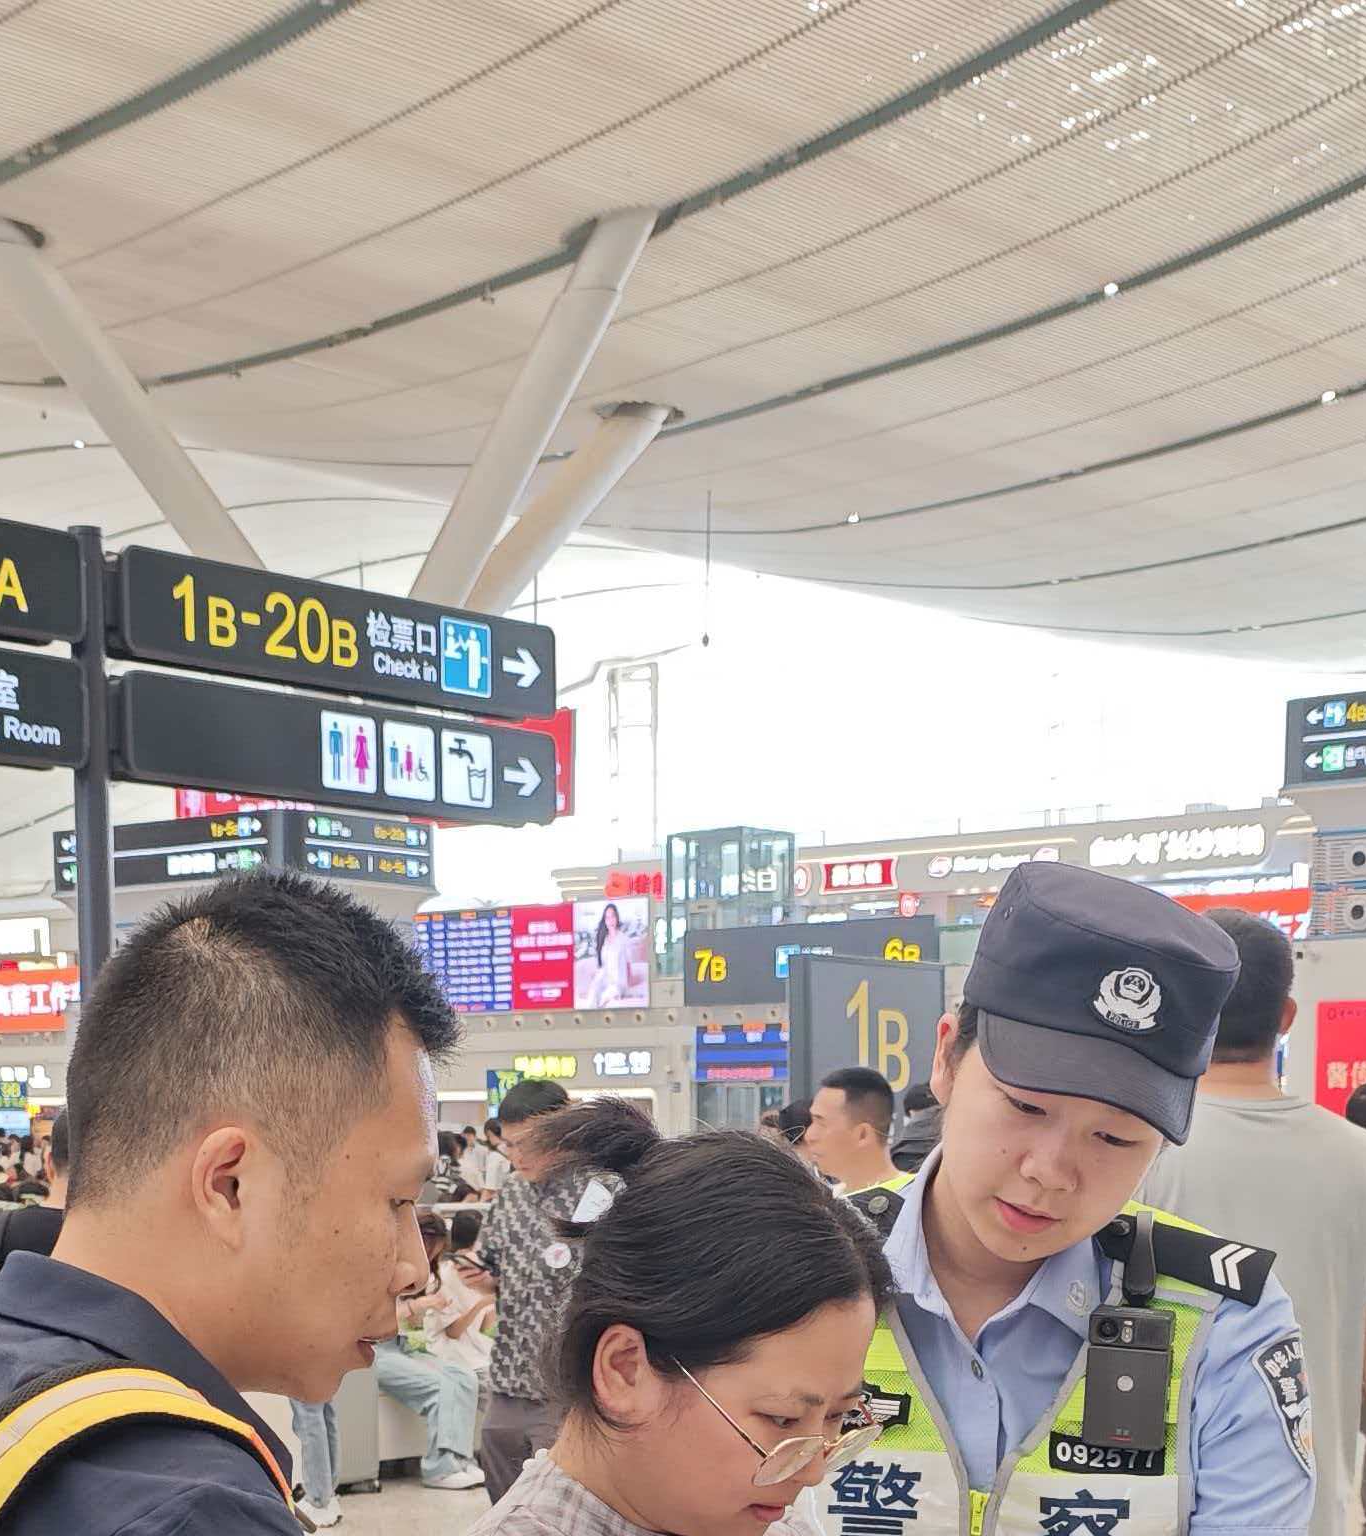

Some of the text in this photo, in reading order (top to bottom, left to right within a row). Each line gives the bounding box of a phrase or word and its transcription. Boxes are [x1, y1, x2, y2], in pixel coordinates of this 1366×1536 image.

[171, 574, 360, 670] 1B-20B
[365, 609, 438, 658] 检票口
[372, 653, 438, 684] Check in
[3, 715, 61, 747] Room
[693, 947, 729, 984] 7B
[846, 980, 912, 1094] 1B
[1108, 1010, 1141, 1030] POLICE
[1055, 1440, 1156, 1470] 092577
